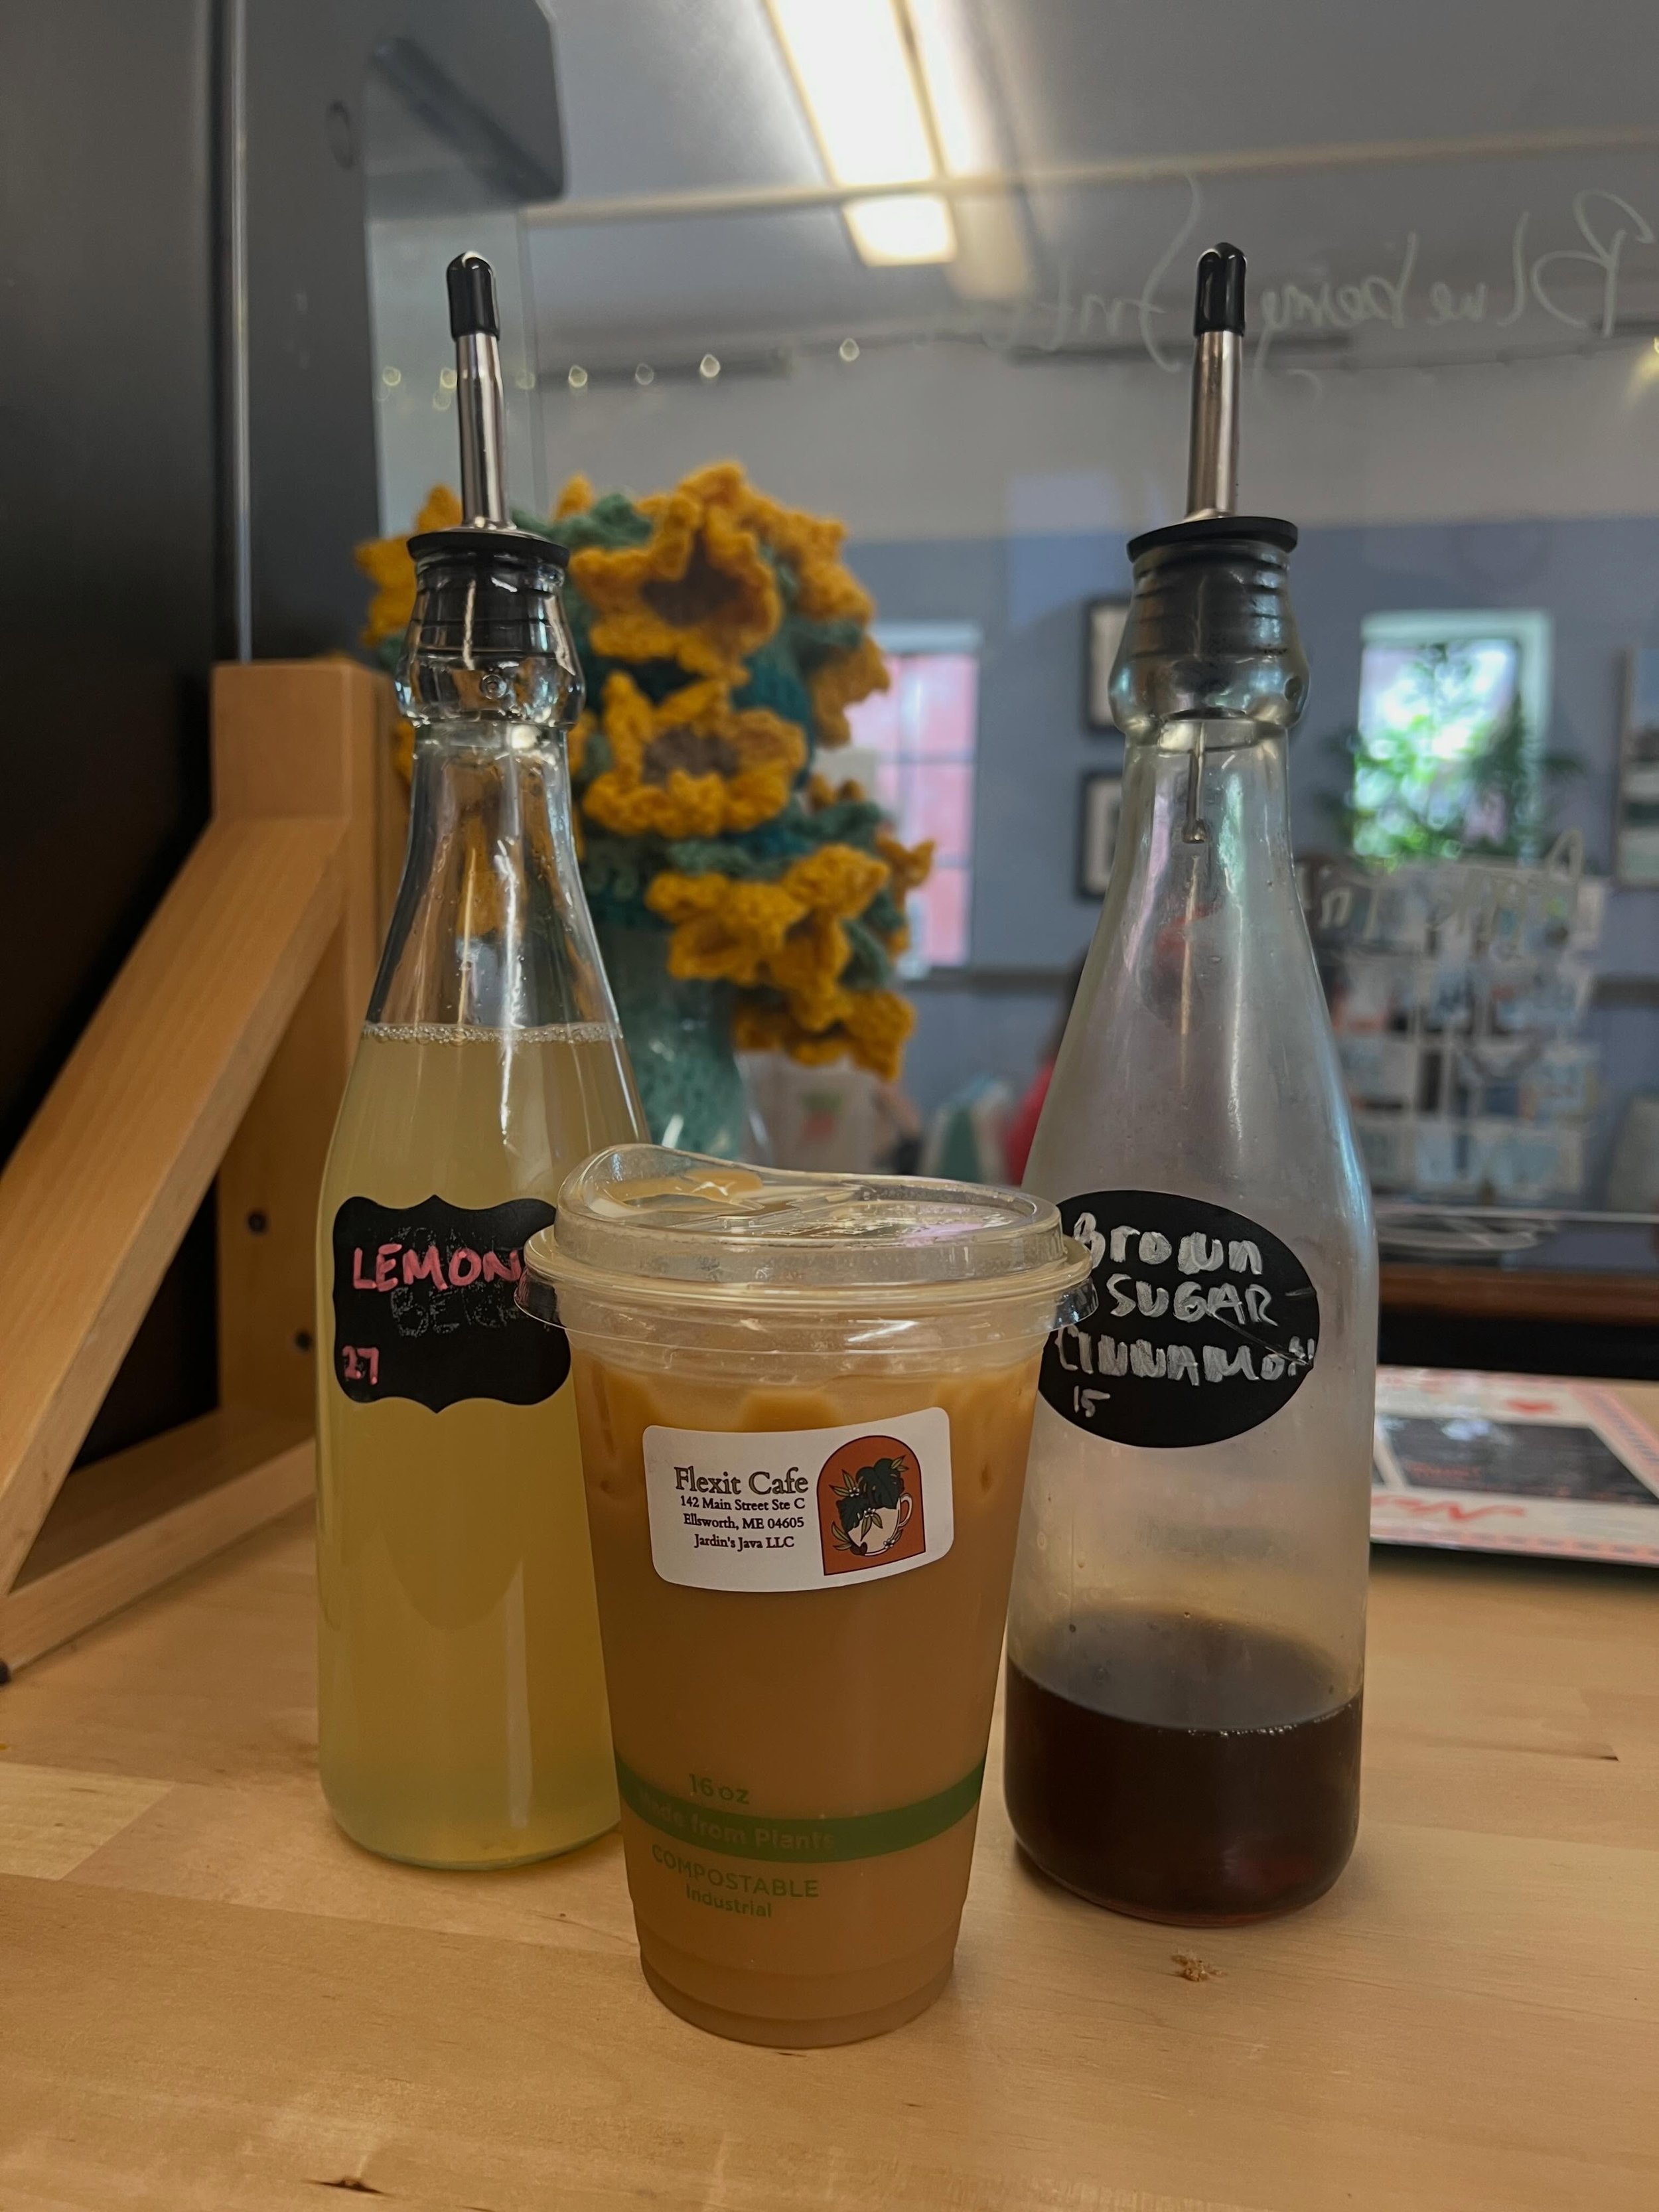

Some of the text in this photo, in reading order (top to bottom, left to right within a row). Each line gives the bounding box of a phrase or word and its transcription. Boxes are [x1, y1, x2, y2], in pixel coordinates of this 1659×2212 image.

[1073, 1212, 1263, 1276] Brown
[352, 1242, 523, 1293] LEMON
[1106, 1273, 1279, 1327] SUGAR
[342, 1345, 379, 1386] 27
[1074, 1385, 1111, 1418] 15
[674, 1465, 809, 1495] Flexit Cafe
[680, 1495, 806, 1511] 142 Main Street Ste C
[683, 1513, 804, 1530] Ellsworth, ME 04605
[694, 1533, 795, 1552] Jardin's Java LLC
[690, 1812, 747, 1846] from
[755, 1828, 835, 1850] Plants
[652, 1844, 820, 1898] COMPOSTABLE
[685, 1883, 772, 1918] Industrial
